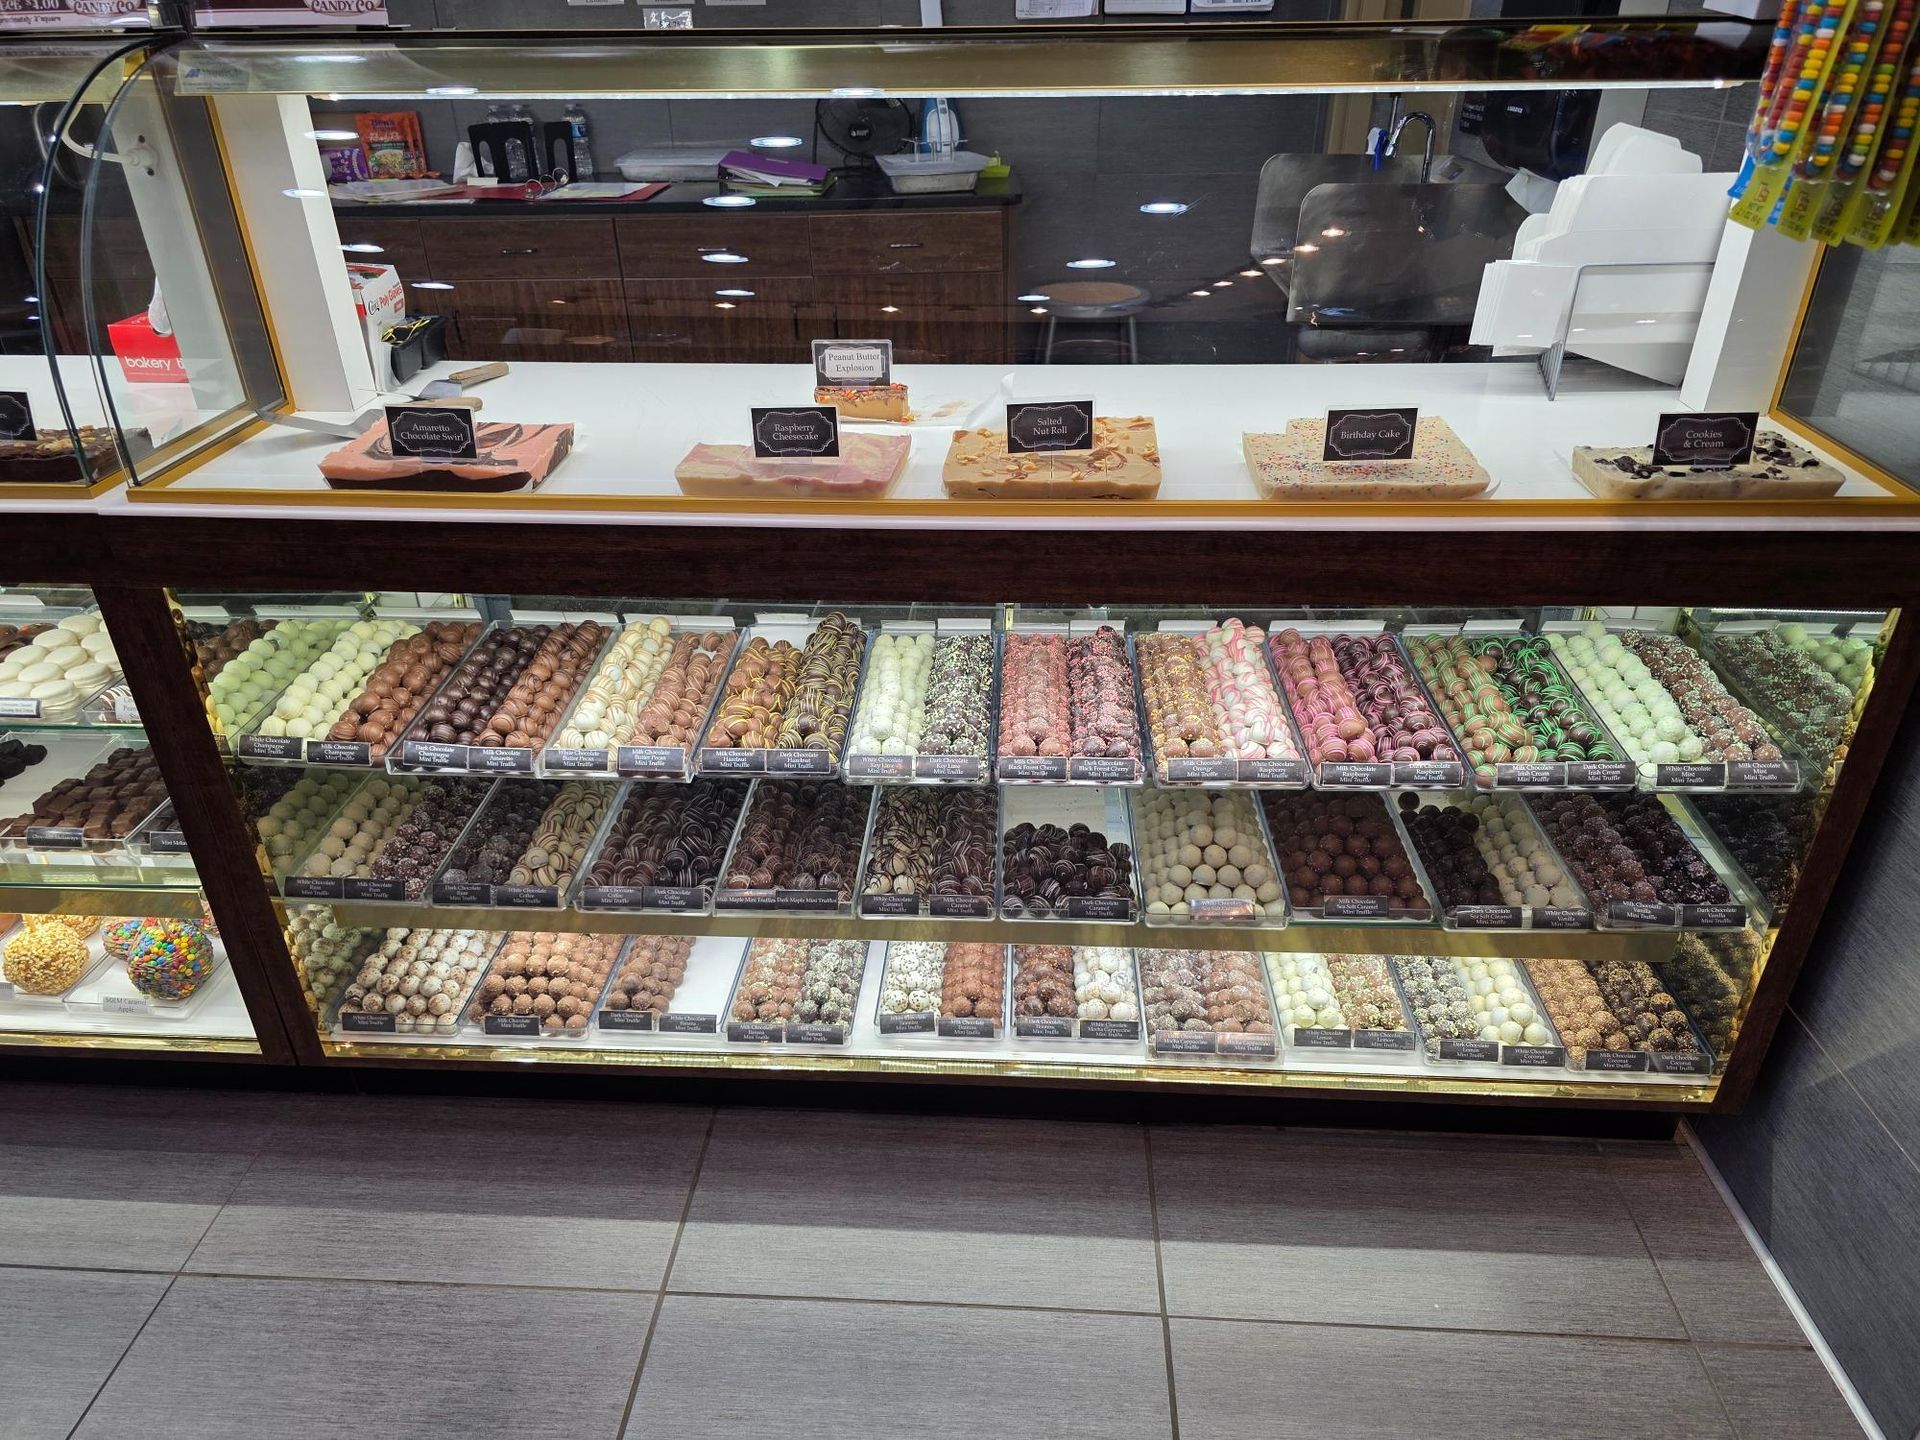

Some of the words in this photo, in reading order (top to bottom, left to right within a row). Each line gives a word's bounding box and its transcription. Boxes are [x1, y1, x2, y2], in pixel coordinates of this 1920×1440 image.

[74, 0, 115, 13] CANDY
[312, 0, 353, 12] CANDY
[856, 352, 880, 361] Butter
[124, 356, 170, 370] bakery
[836, 364, 874, 374] Explosion
[1037, 417, 1062, 425] Salted
[413, 423, 450, 432] Amaretto
[775, 424, 814, 433] Raspberry
[401, 432, 440, 440] Chocolate
[442, 433, 463, 441] Swirl
[772, 432, 818, 440] Cheesecake
[1341, 431, 1376, 440] Birthday
[1686, 430, 1722, 438] Cookies
